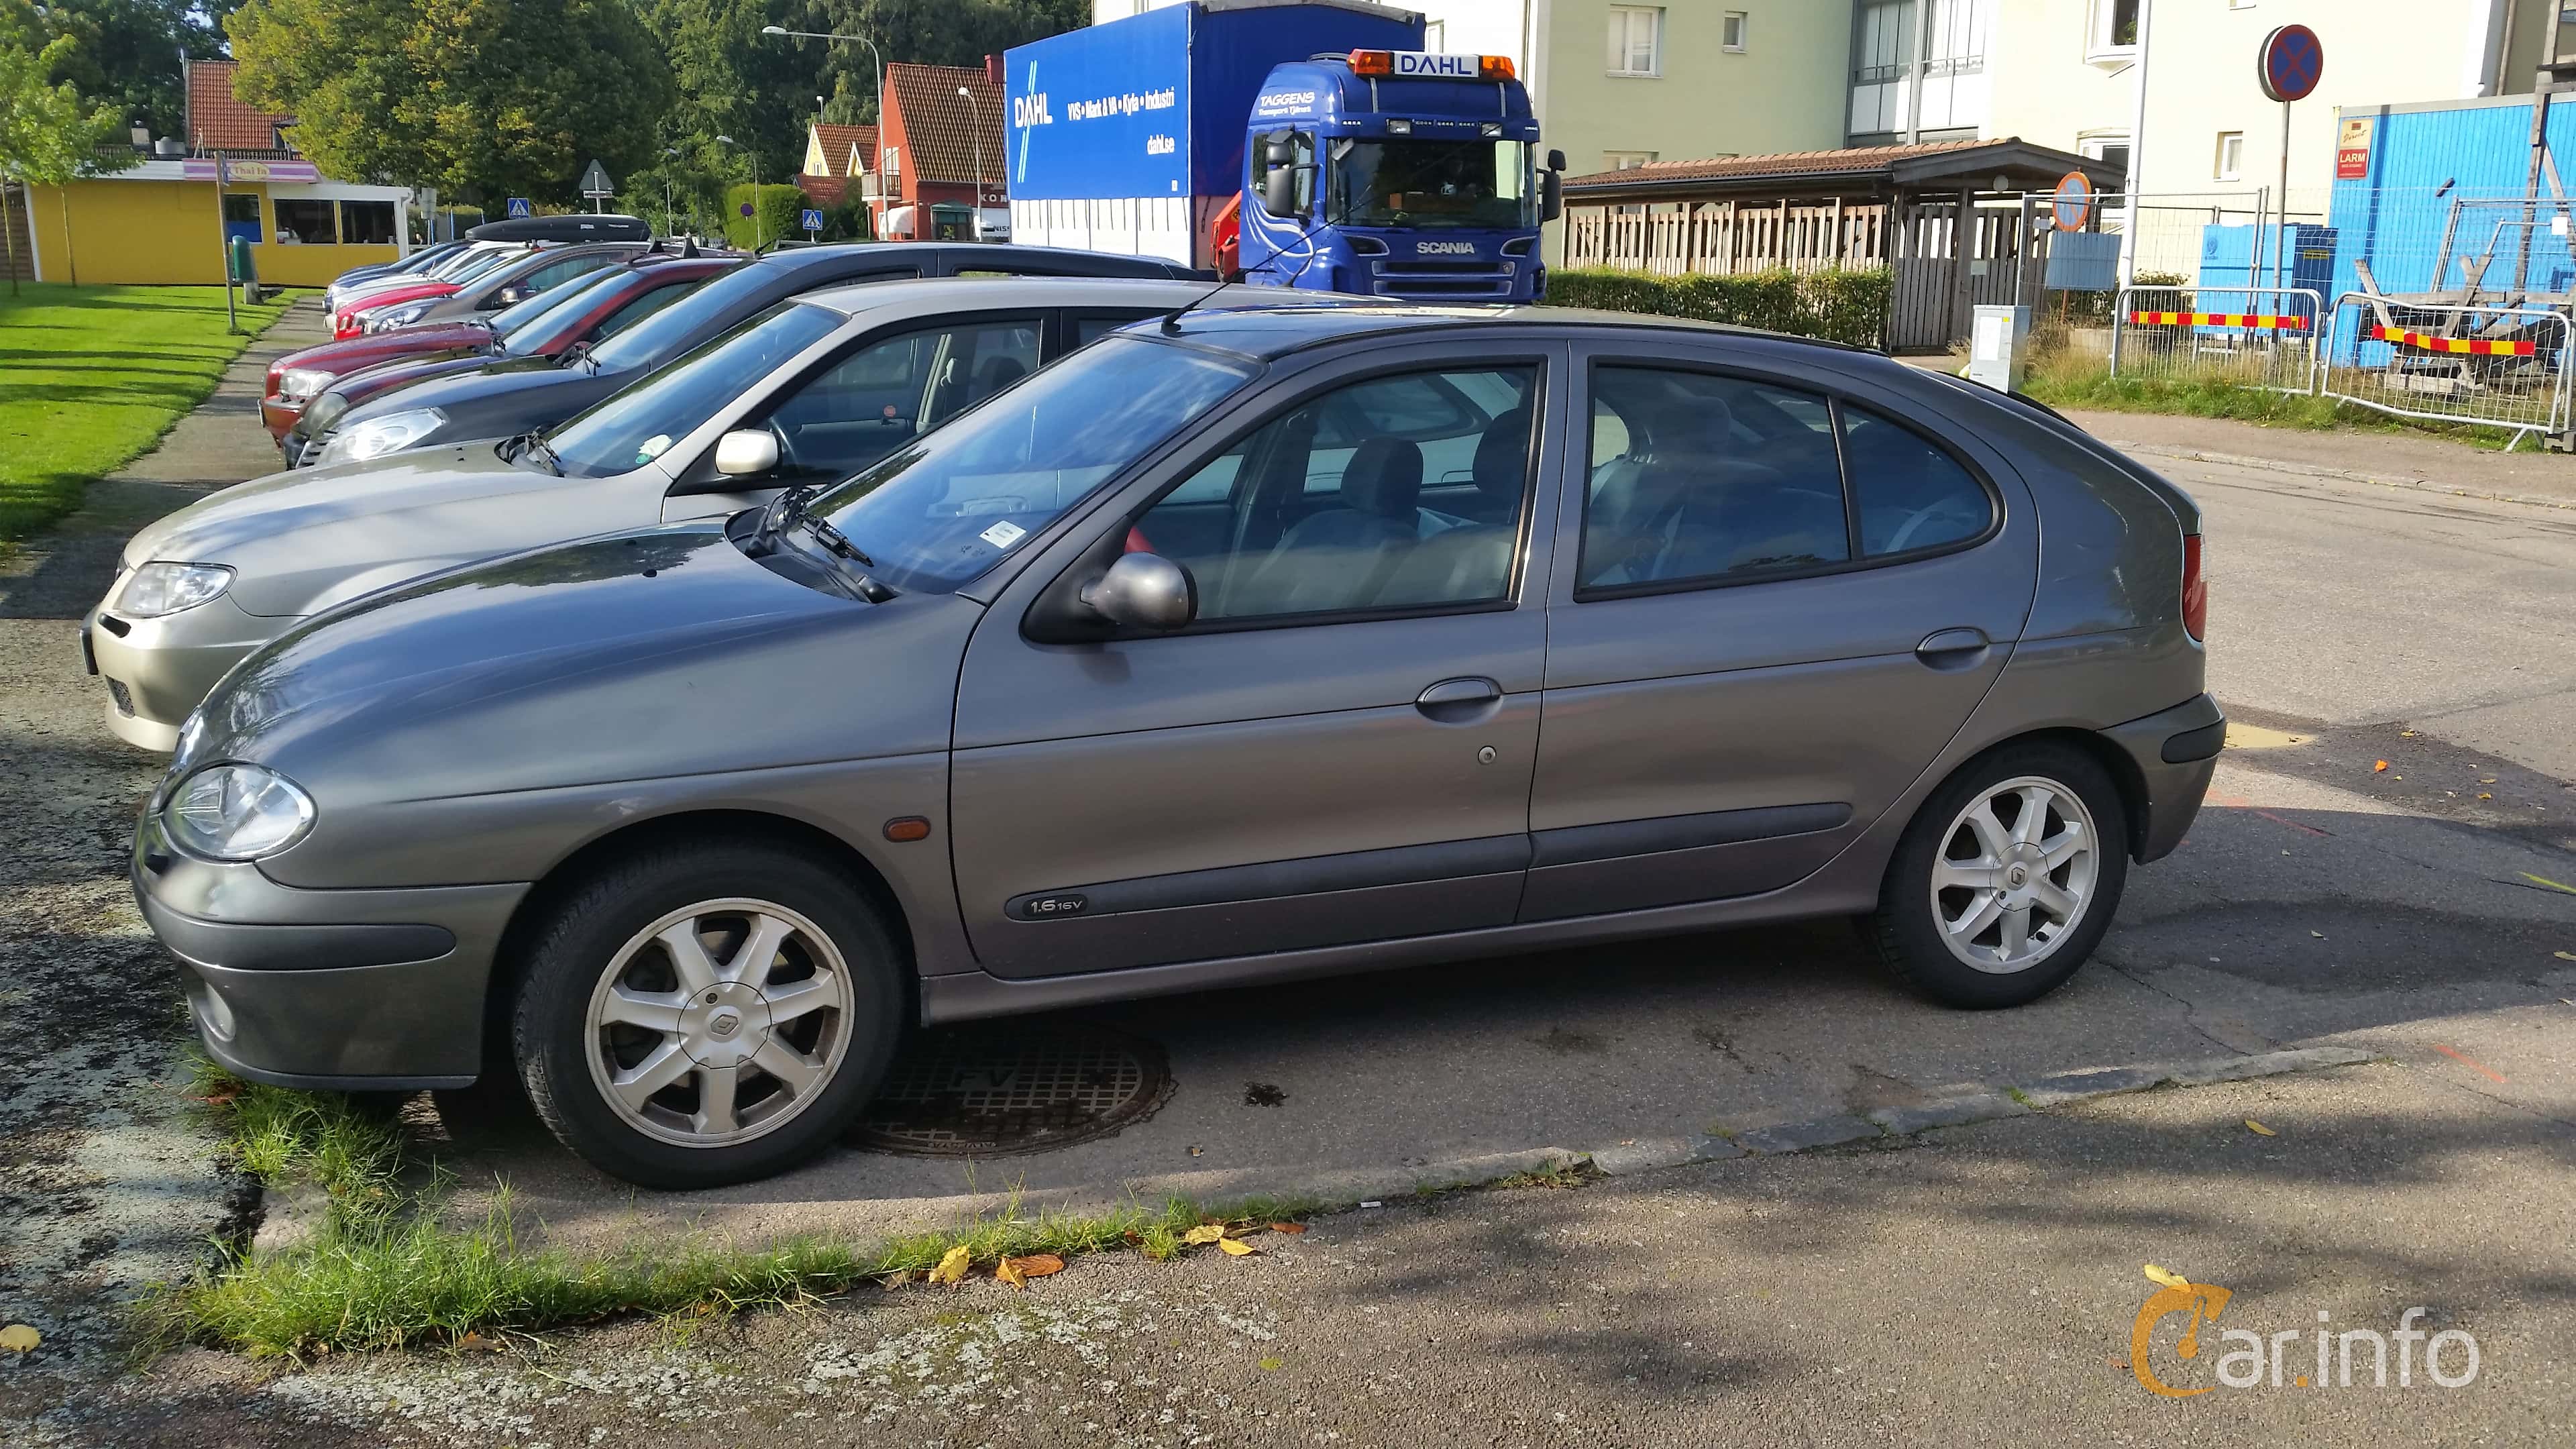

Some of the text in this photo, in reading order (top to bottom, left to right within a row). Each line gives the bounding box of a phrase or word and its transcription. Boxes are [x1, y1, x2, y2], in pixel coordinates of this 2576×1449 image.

[1401, 55, 1472, 74] DAHL
[1067, 101, 1081, 121] VVS
[1102, 97, 1108, 117] &
[1145, 85, 1175, 110] Industri
[1260, 92, 1315, 107] TAGGENS
[1014, 92, 1053, 127] DAHL
[1147, 134, 1175, 155] dahl.se
[2340, 154, 2365, 162] LARM
[1417, 242, 1474, 254] SCANIA
[1031, 900, 1083, 913] 1.6 16V
